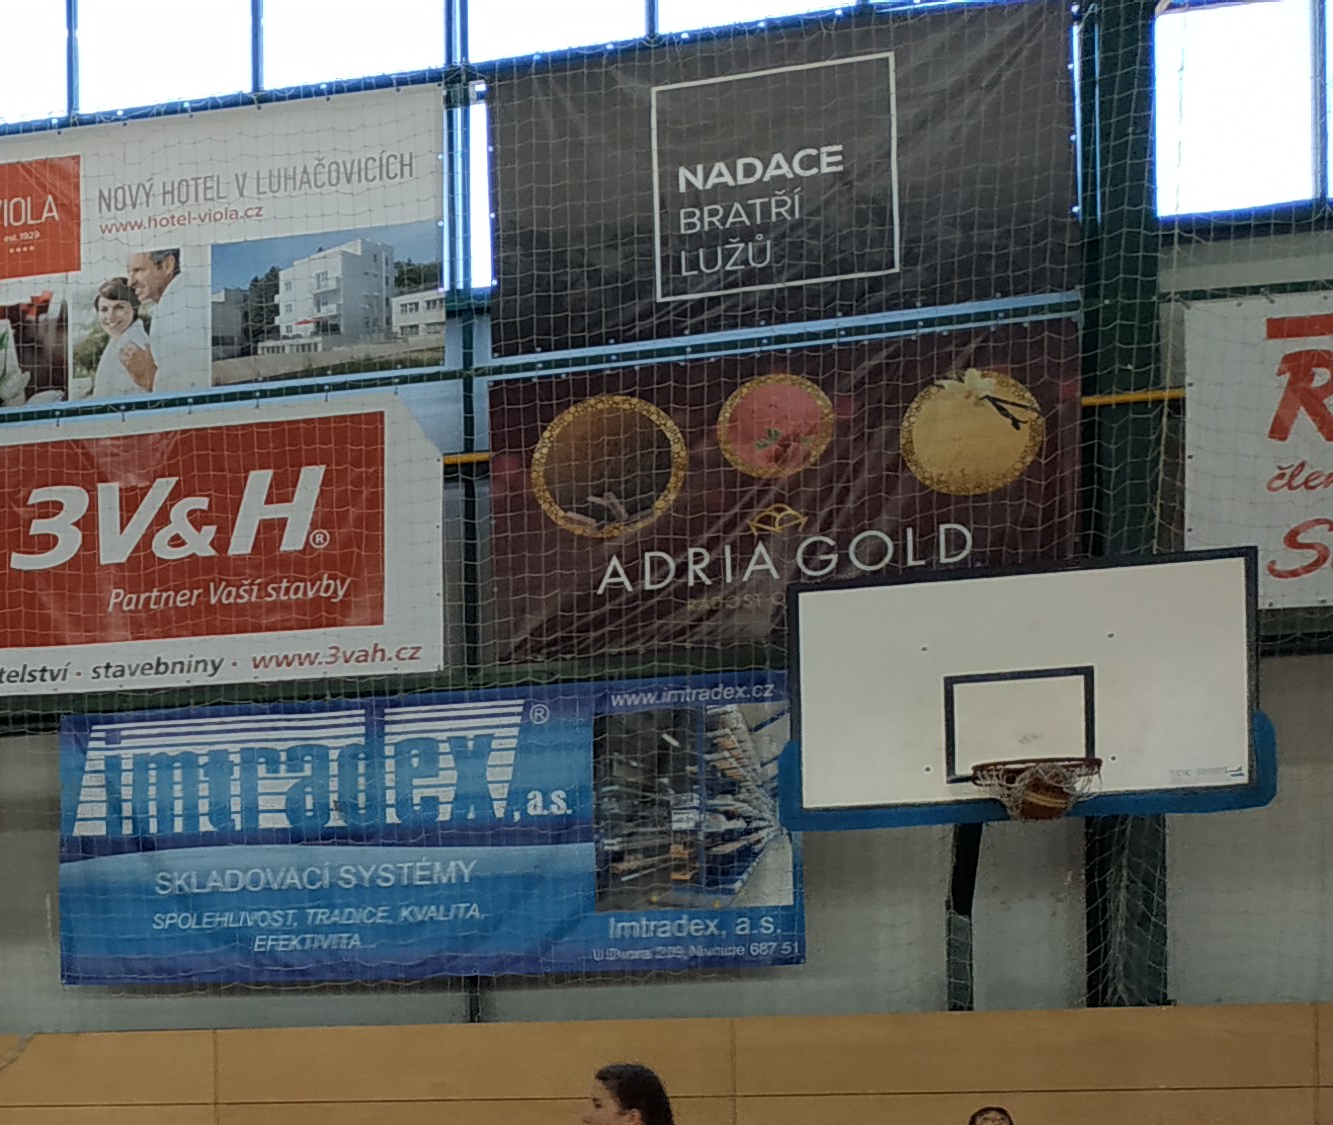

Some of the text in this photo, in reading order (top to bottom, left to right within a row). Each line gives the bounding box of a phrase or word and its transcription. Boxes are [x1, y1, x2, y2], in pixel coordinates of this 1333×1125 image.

[97, 150, 414, 215] NOVÝ HOTEL V LUHAČOVICÍCH
[678, 144, 844, 193] NADACE
[99, 205, 264, 235] www.hotel-viola.cz
[679, 188, 803, 235] BRATŘÍ
[680, 233, 772, 276] LUŽŮ
[10, 465, 326, 571] 3V&H
[596, 523, 973, 595] ADRIA GOLD
[107, 574, 351, 613] Partner Vaší stavby
[91, 653, 224, 681] stavebniny
[252, 643, 423, 670] www.3vah.cz
[611, 683, 775, 707] www.imtradex.cz
[526, 789, 573, 816] a.s.
[155, 852, 478, 895] SKLADOVACÍ SYSTÉMY
[608, 914, 727, 940] Imtradex,
[750, 942, 777, 957] 687
[781, 941, 800, 955] 51
